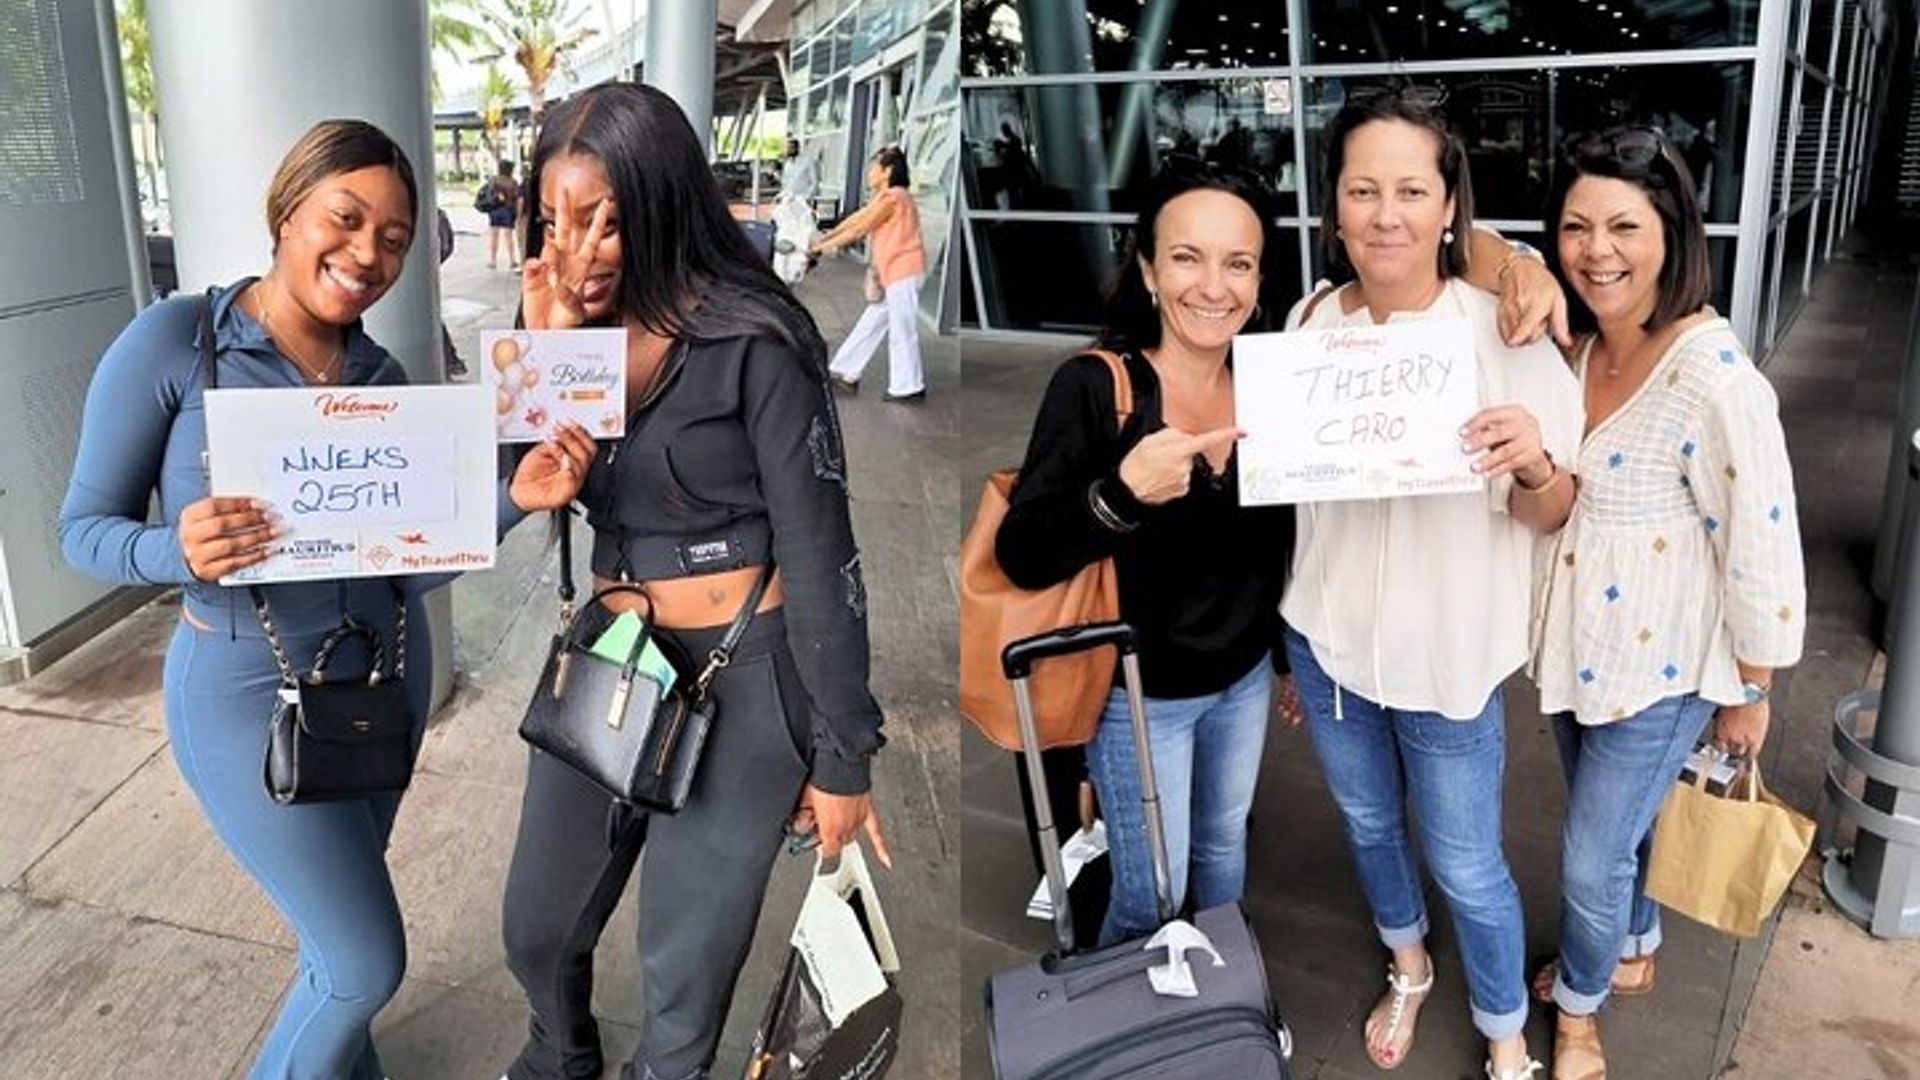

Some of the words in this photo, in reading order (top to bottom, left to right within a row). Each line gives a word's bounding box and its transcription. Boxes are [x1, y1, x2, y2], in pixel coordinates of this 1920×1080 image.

[1293, 353, 1453, 406] THIERRY
[1315, 412, 1407, 445] CARO
[282, 444, 410, 473] NNEKS
[292, 479, 401, 514] 25TH
[402, 552, 489, 568] MyTravelThru
